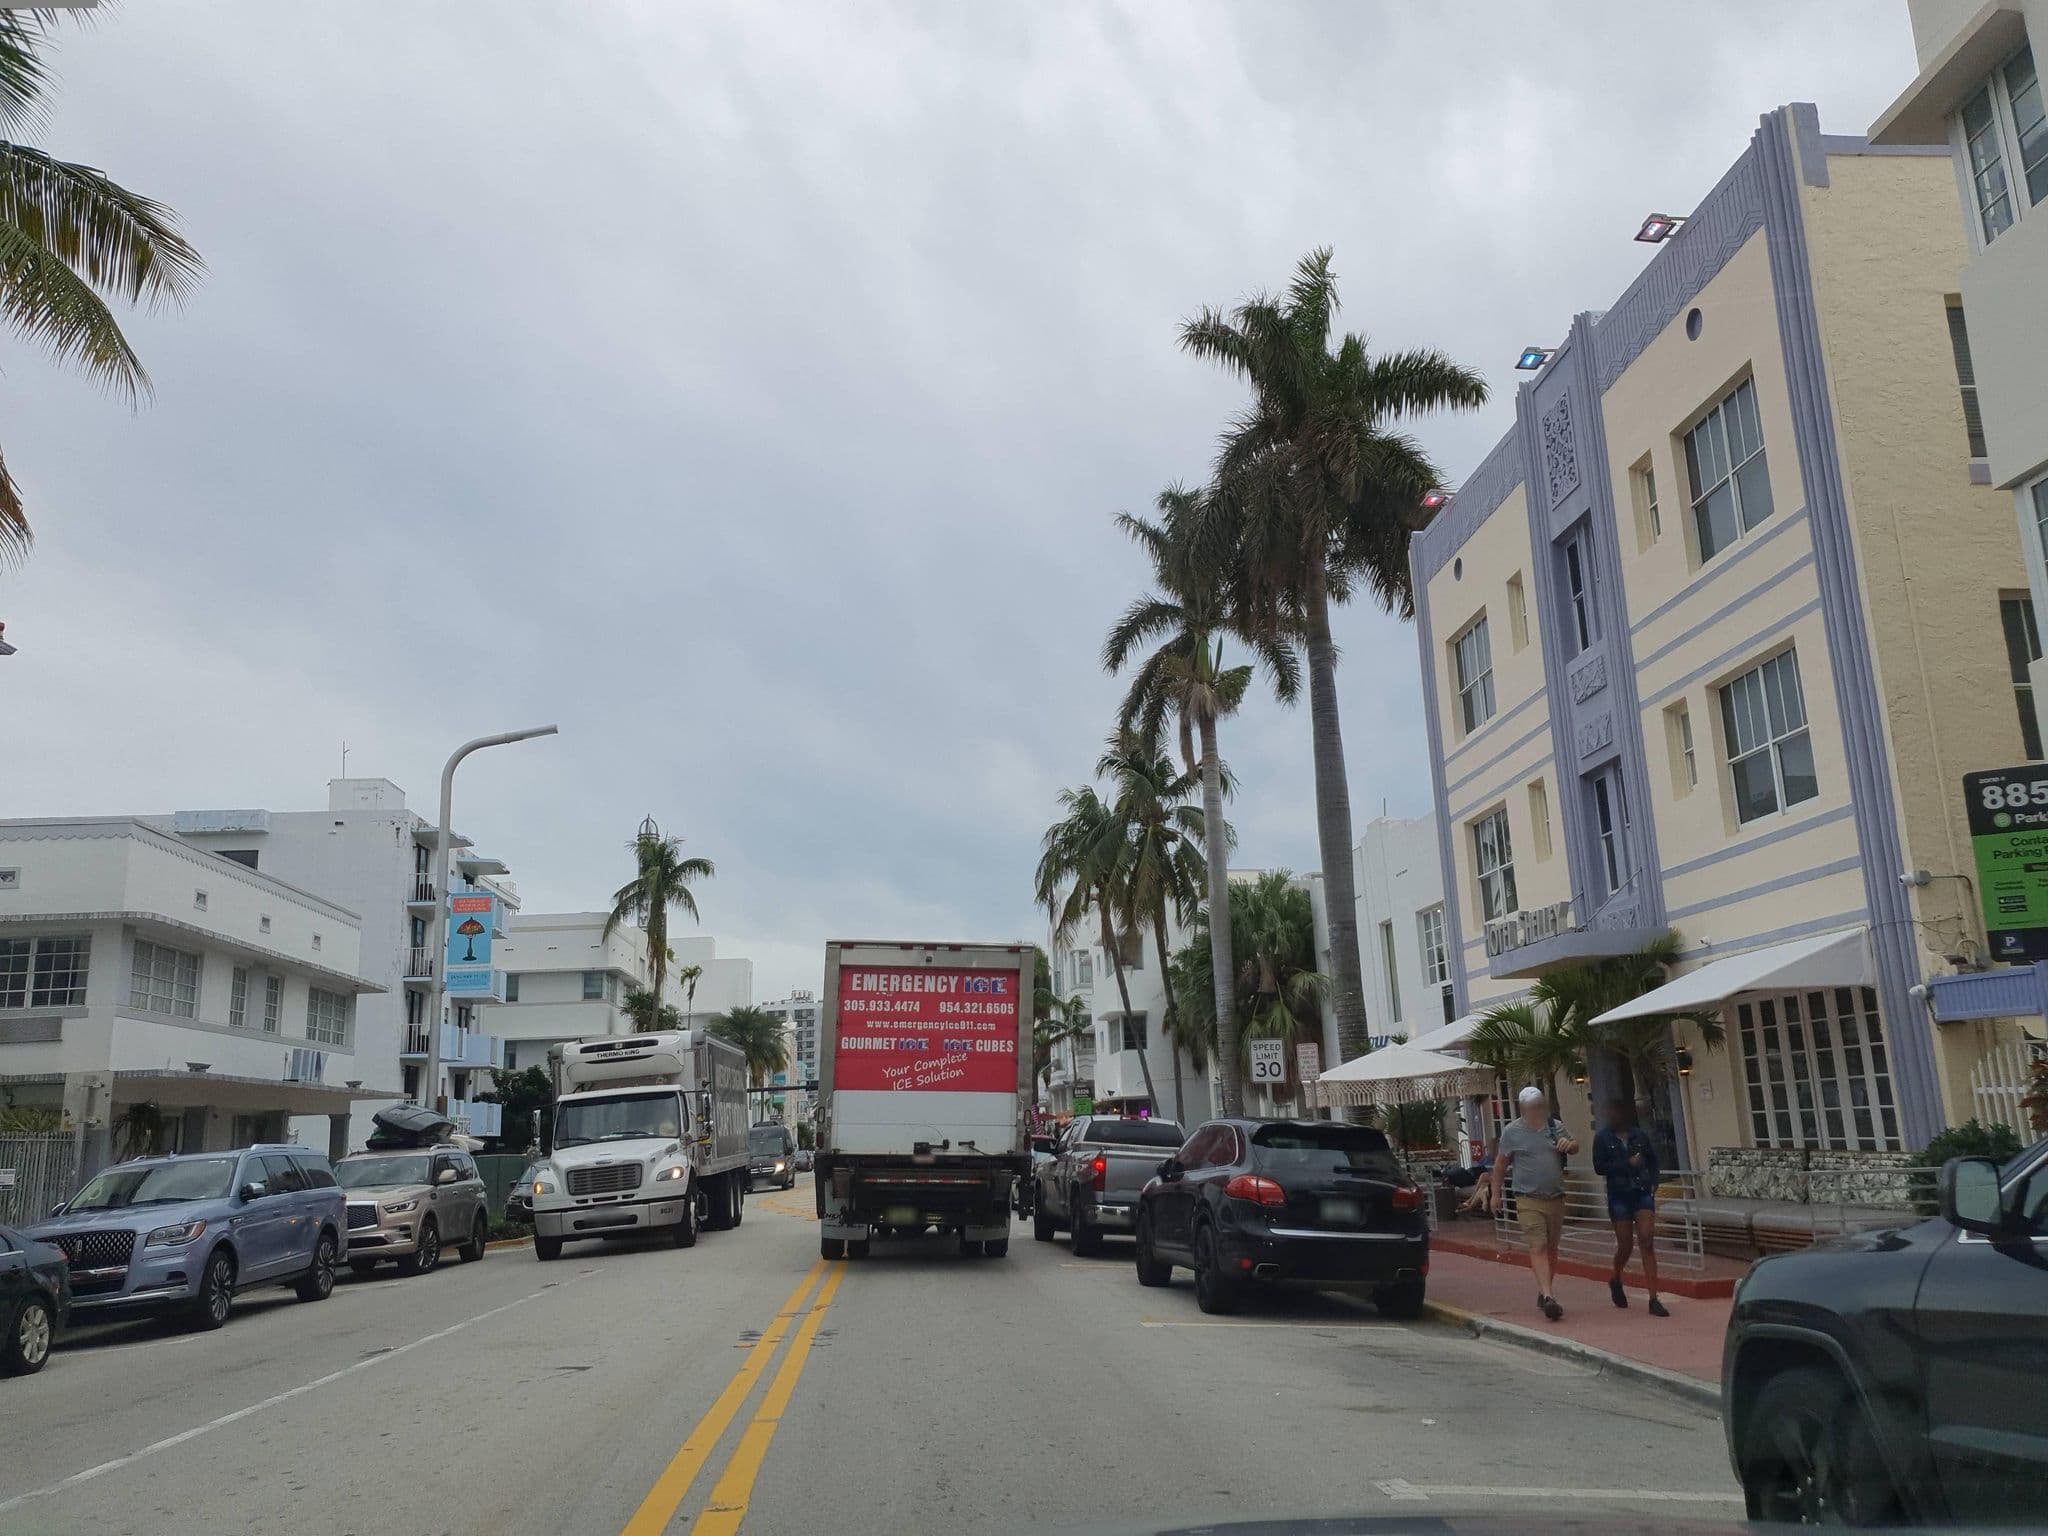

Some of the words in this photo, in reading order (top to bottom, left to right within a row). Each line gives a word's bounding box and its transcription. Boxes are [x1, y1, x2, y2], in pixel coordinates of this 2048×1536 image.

[1982, 780, 2048, 810] 885
[1992, 848, 2043, 860] Parking
[2005, 936, 2016, 947] P
[851, 973, 959, 993] EMERGENCY
[963, 976, 1008, 995] ICE
[843, 999, 921, 1013] 305.933.4474
[841, 1036, 897, 1050] GOURMET
[898, 1037, 930, 1051] ICE
[943, 1038, 974, 1052] ICE
[975, 1039, 1014, 1053] CUBES
[1252, 1043, 1281, 1051] SPEED
[596, 1051, 624, 1059] THERMO
[1256, 1052, 1278, 1060] LIMIT
[881, 1064, 910, 1079] Your
[913, 1052, 968, 1072] Complete
[1255, 1061, 1282, 1077] 30
[893, 1077, 913, 1091] ICE
[916, 1068, 965, 1086] Solution
